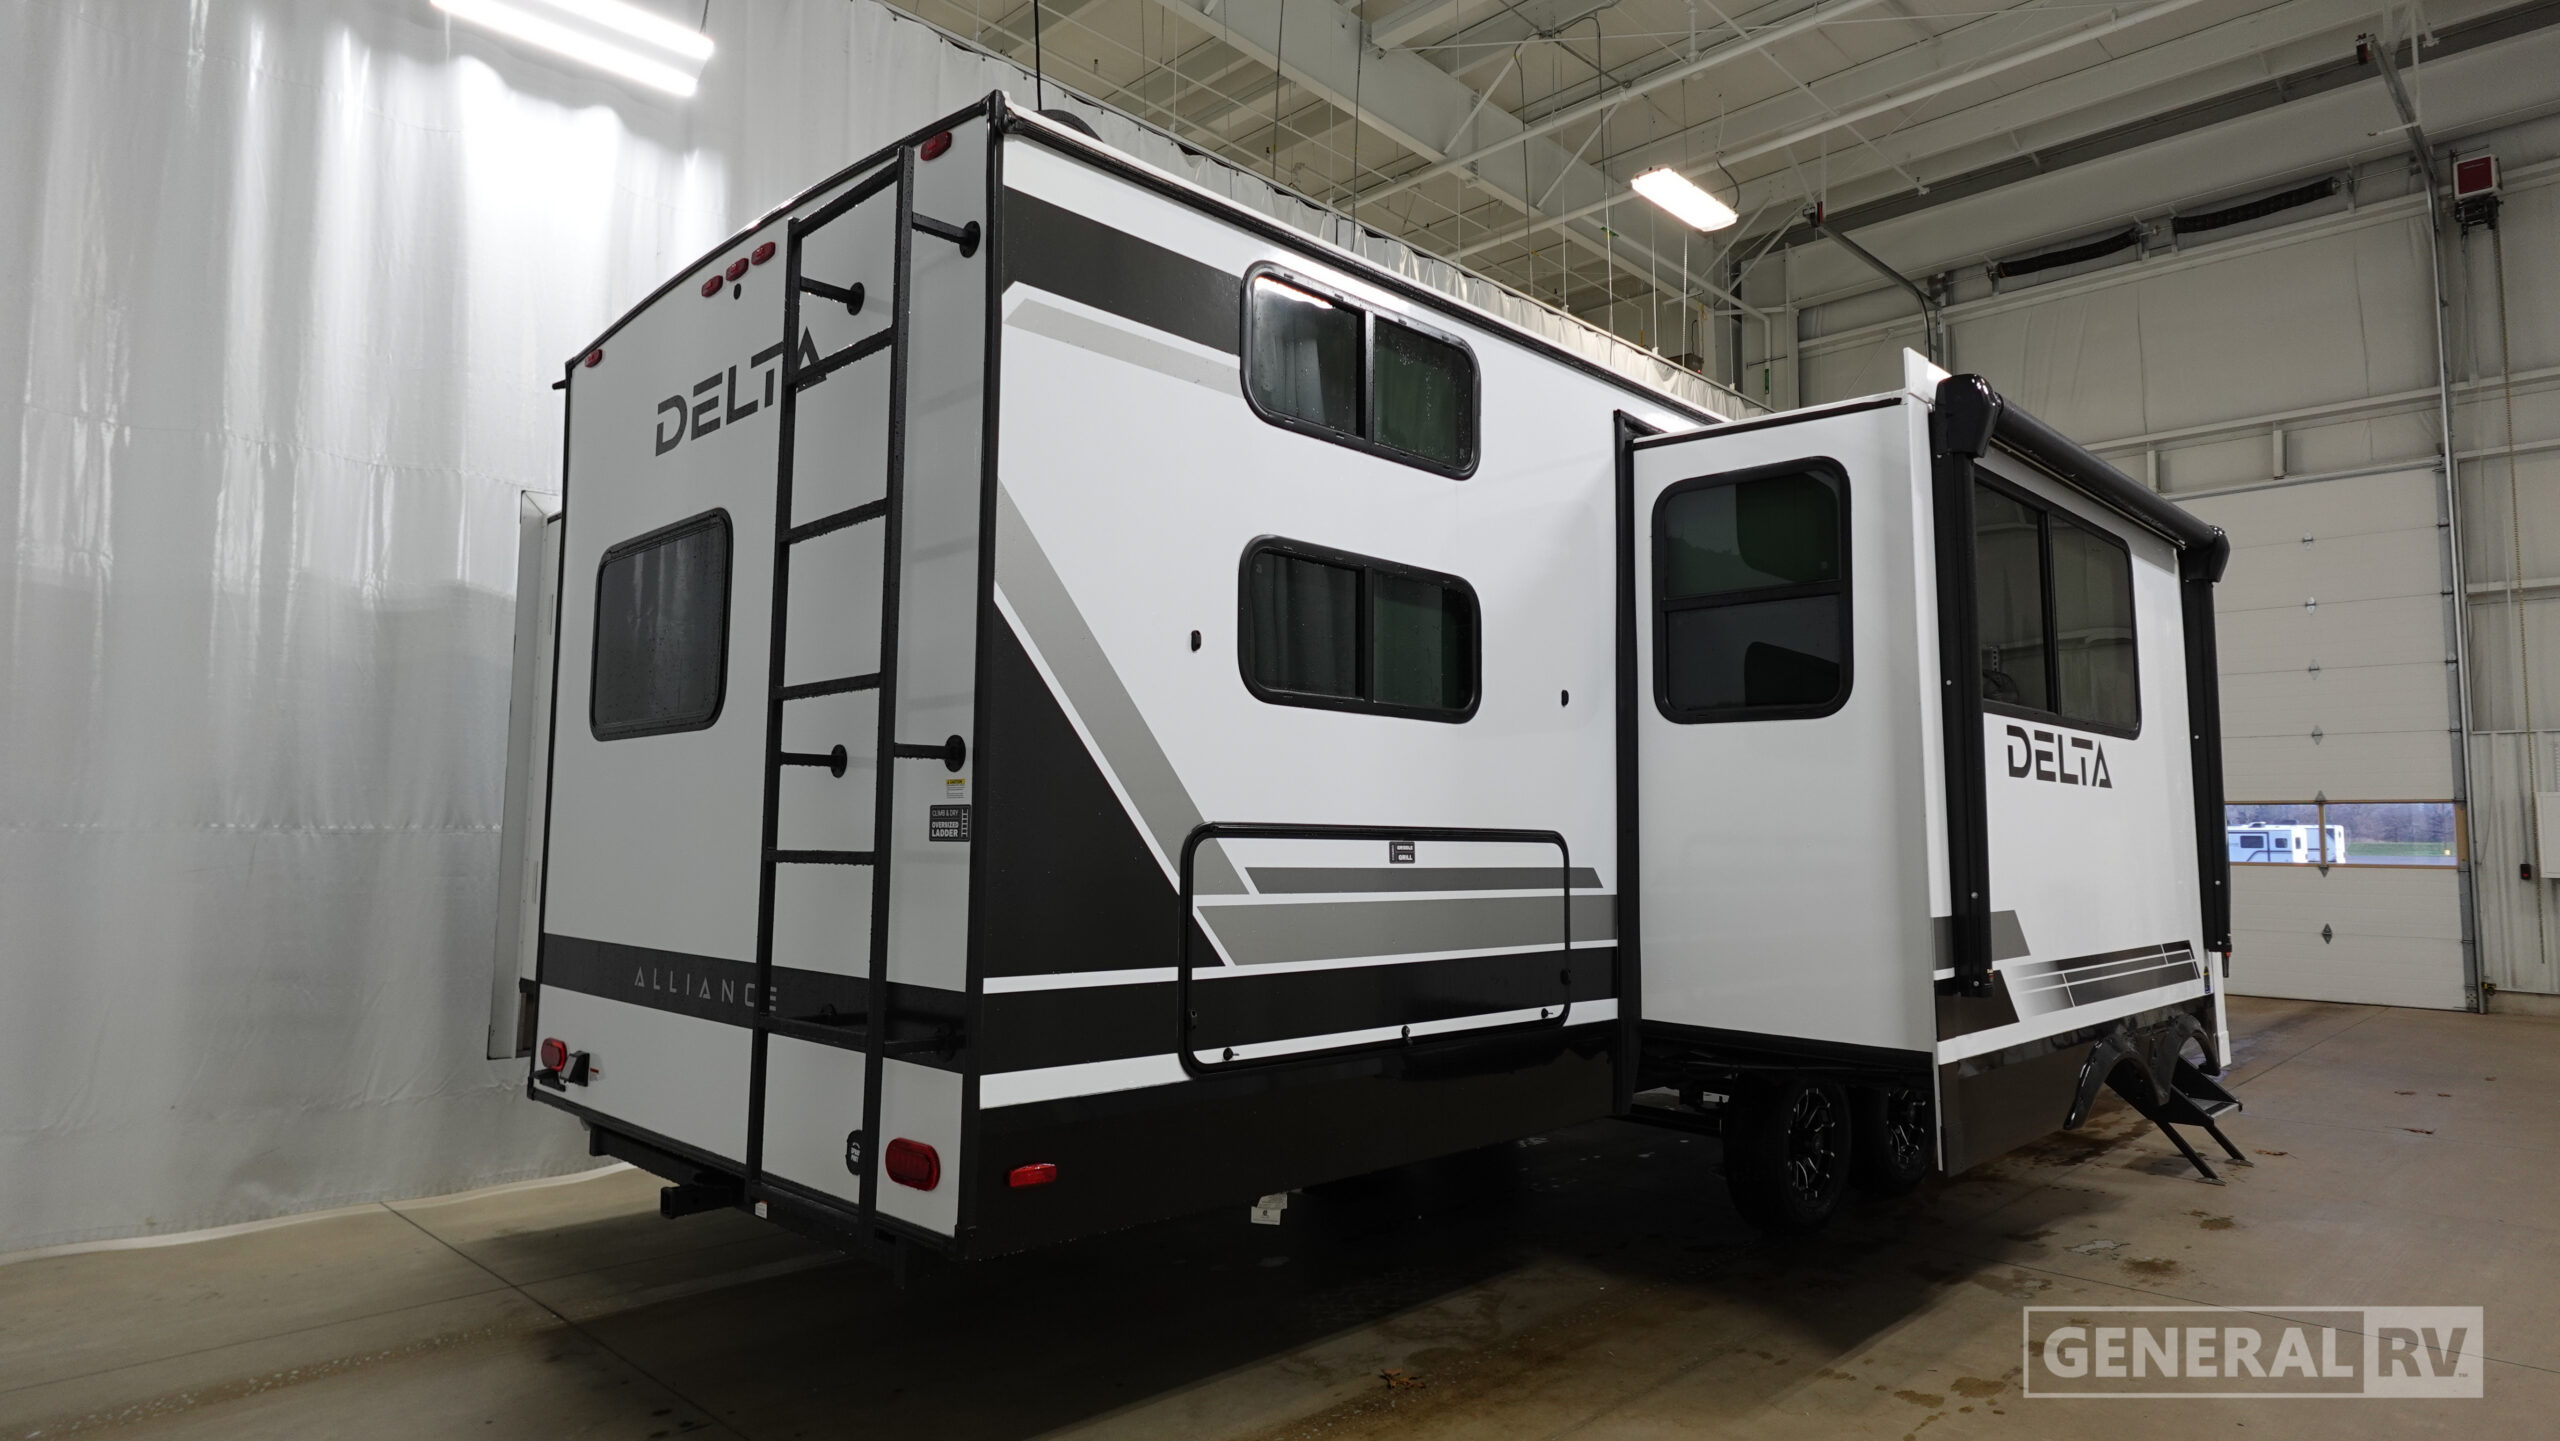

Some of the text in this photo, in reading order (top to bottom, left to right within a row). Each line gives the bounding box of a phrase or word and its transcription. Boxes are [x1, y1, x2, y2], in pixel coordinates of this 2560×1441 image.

[2006, 724, 2113, 789] DELTA
[931, 809, 945, 817] CLIMB
[950, 809, 959, 817] DRY
[931, 829, 959, 837] LADDER
[634, 966, 777, 1012] ALLIANCE
